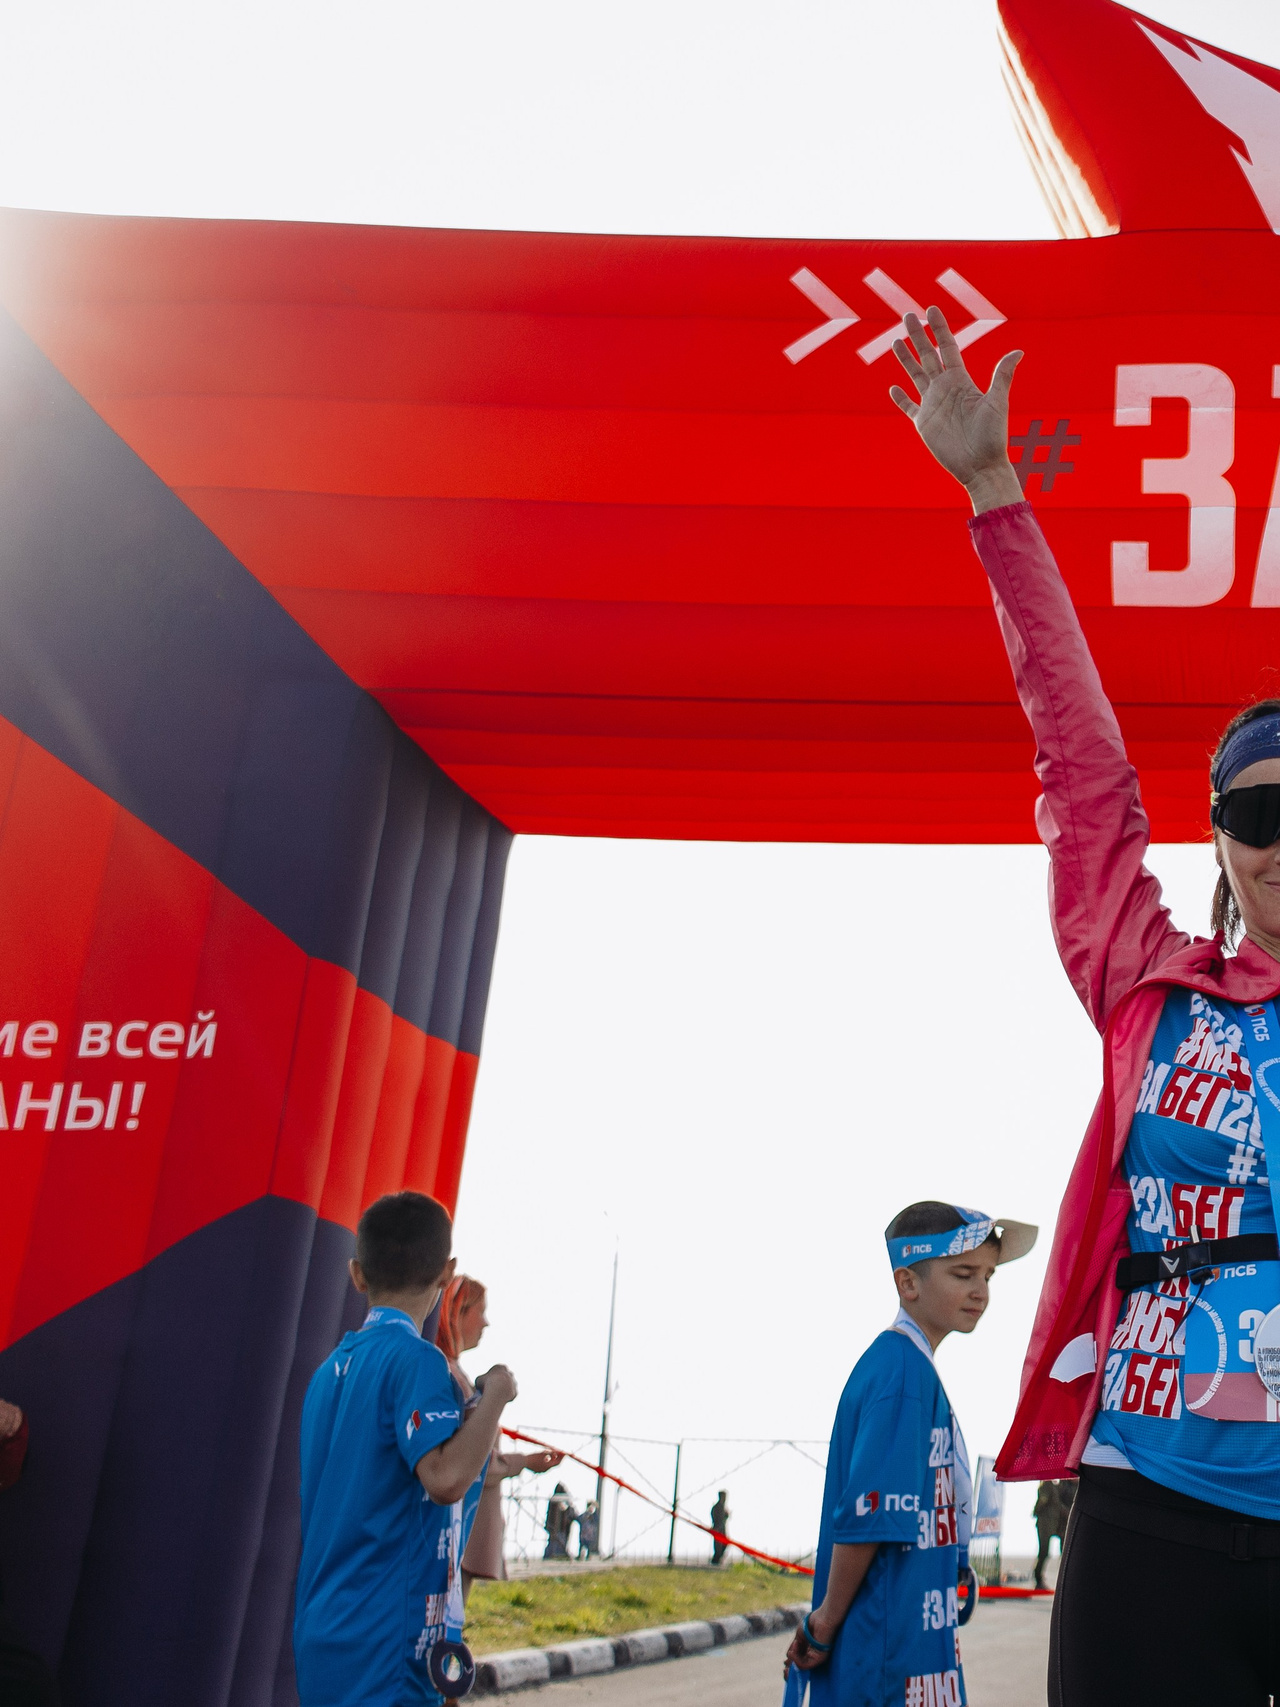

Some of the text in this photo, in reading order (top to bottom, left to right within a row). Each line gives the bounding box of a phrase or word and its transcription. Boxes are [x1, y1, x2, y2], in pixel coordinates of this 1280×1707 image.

[78, 1010, 217, 1059] всей
[1250, 1018, 1270, 1042] ПСБ
[0, 1081, 146, 1131] НЫ!
[913, 1244, 932, 1254] ПСБ
[1224, 1264, 1257, 1279] ПСБ
